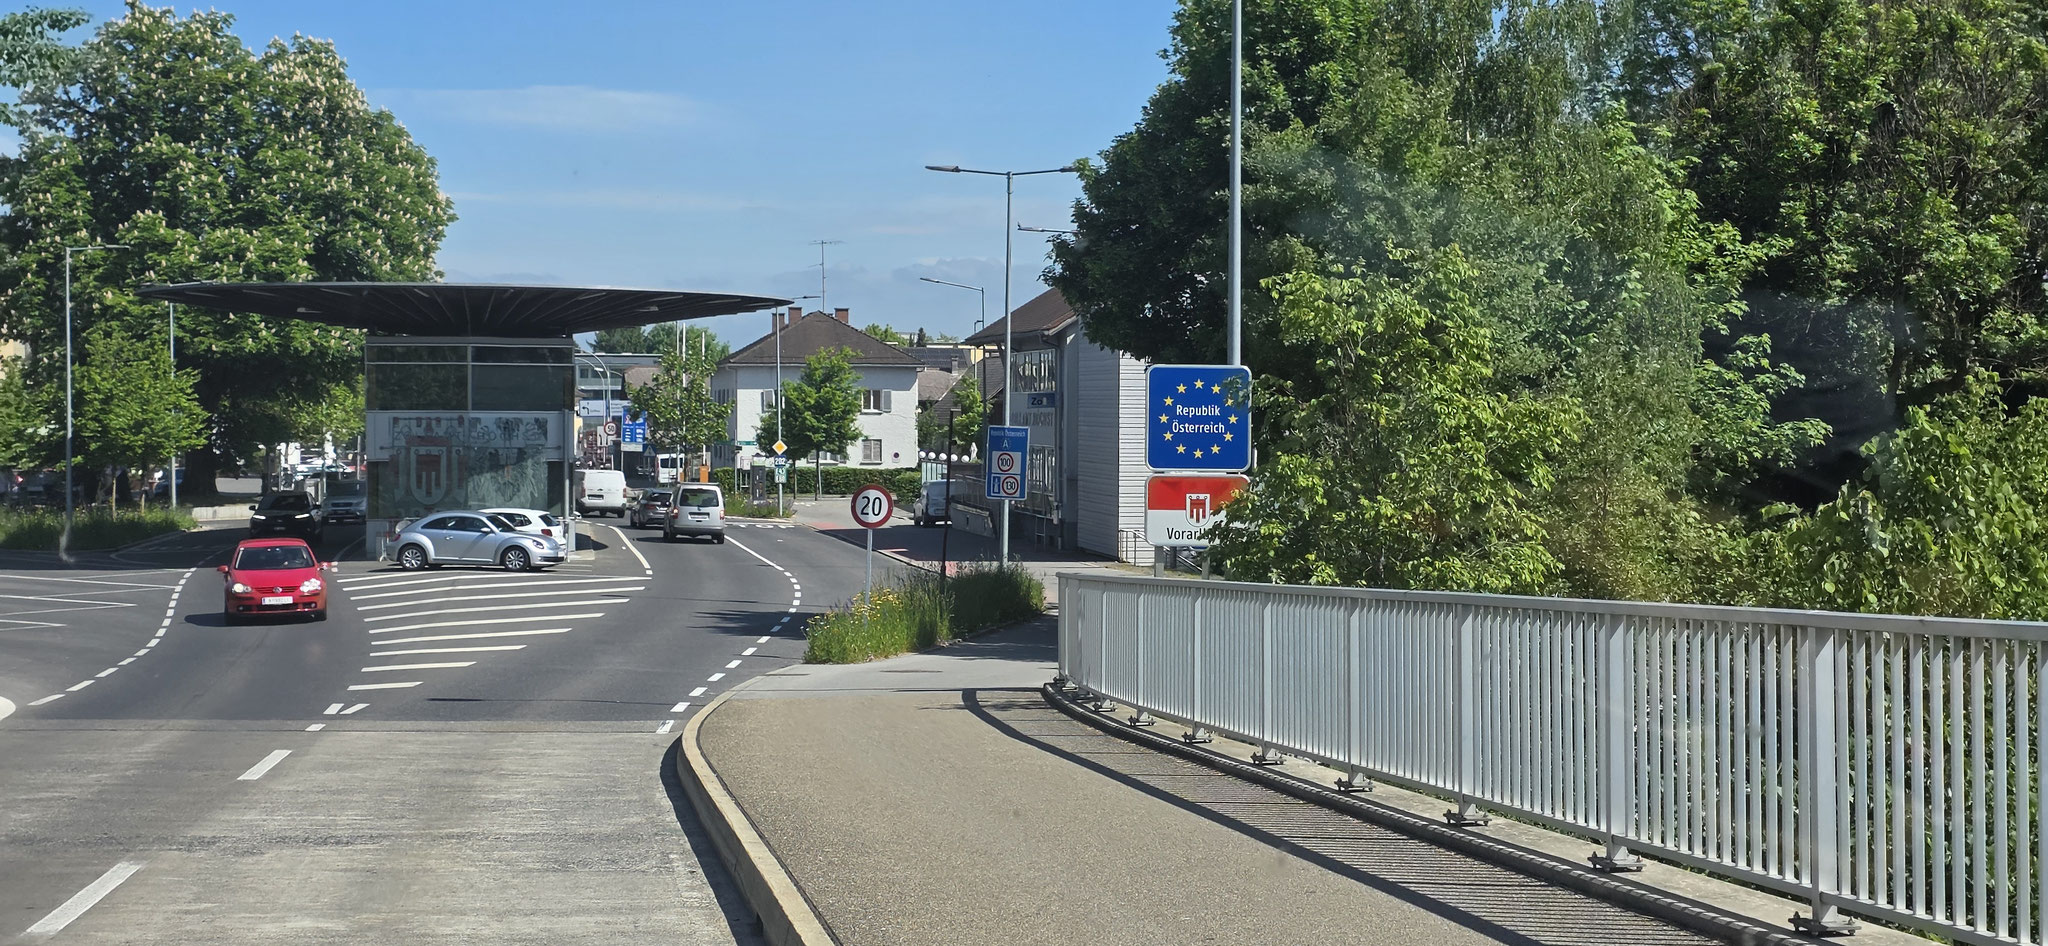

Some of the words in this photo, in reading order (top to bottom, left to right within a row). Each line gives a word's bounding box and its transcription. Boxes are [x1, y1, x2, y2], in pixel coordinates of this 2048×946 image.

[1176, 404, 1221, 418] Republik
[1172, 419, 1225, 433] Österreich
[774, 457, 786, 466] 202
[1000, 457, 1011, 467] 100
[1005, 480, 1016, 490] 130
[861, 495, 882, 516] 20
[1166, 527, 1205, 541] Vorar
